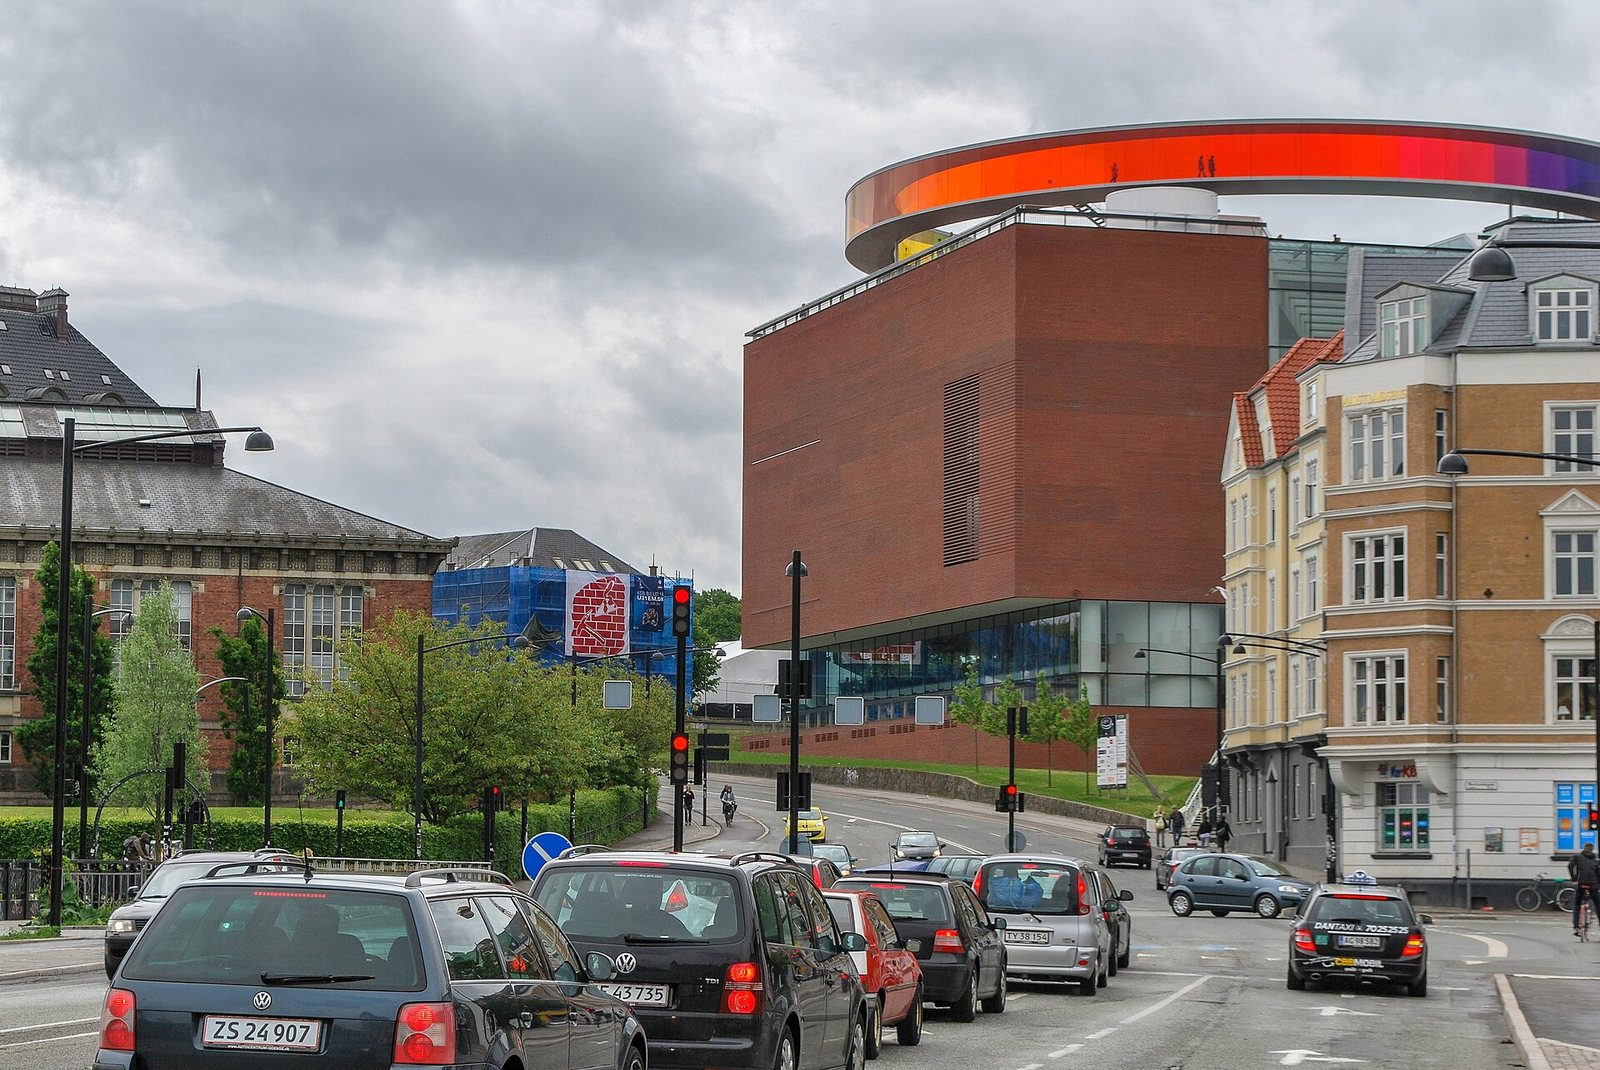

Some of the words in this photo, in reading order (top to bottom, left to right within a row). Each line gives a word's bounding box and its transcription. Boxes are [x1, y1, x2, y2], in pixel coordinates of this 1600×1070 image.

[1314, 922, 1355, 931] DANTAXI
[1019, 932, 1030, 940] 38
[1033, 933, 1047, 941] 154
[613, 985, 632, 999] 43
[635, 987, 664, 1001] 735
[213, 1021, 240, 1040] ZS
[244, 1022, 269, 1041] 24
[273, 1024, 311, 1043] 907
